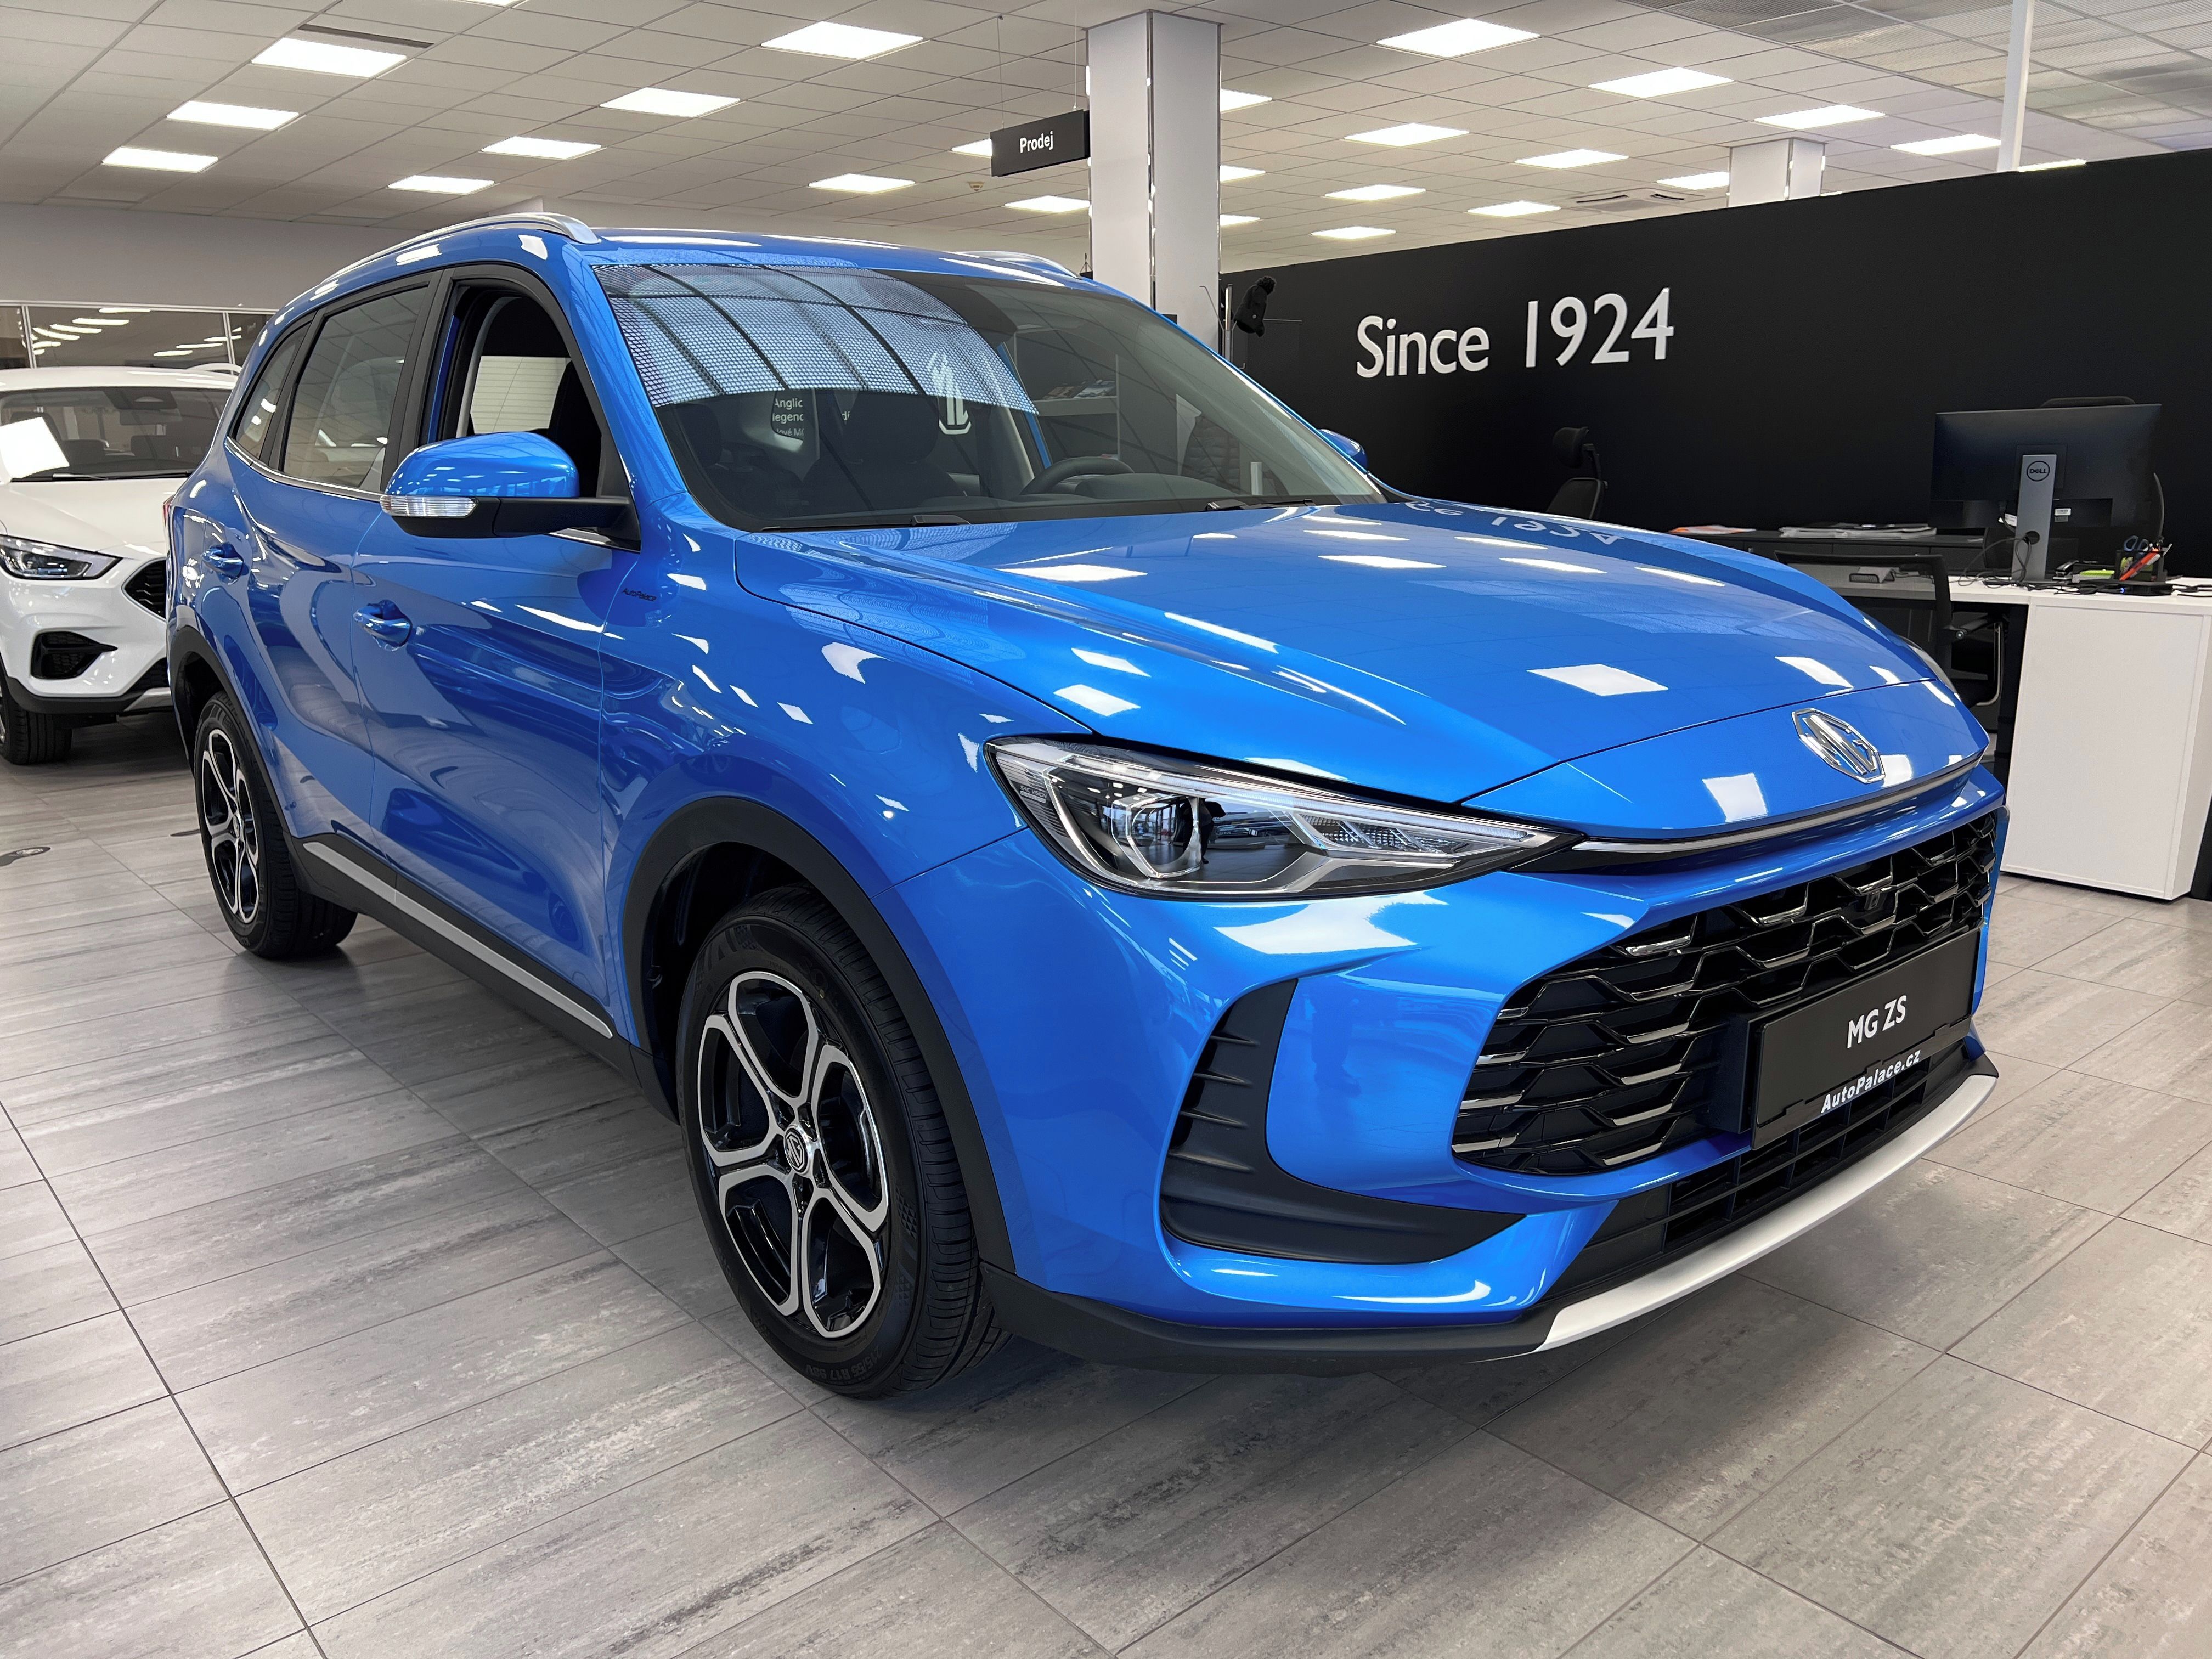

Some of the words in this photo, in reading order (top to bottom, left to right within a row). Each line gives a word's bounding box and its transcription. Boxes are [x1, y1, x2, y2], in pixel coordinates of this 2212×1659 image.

[1020, 131, 1053, 153] Prodej
[1356, 315, 1490, 378] Since
[1525, 287, 1674, 368] 1924
[1798, 712, 1881, 778] MG
[1847, 1008, 1879, 1049] MG
[1882, 994, 1907, 1031] ZS
[1821, 1049, 1921, 1114] AutoPalace.cz
[786, 1133, 804, 1169] MG
